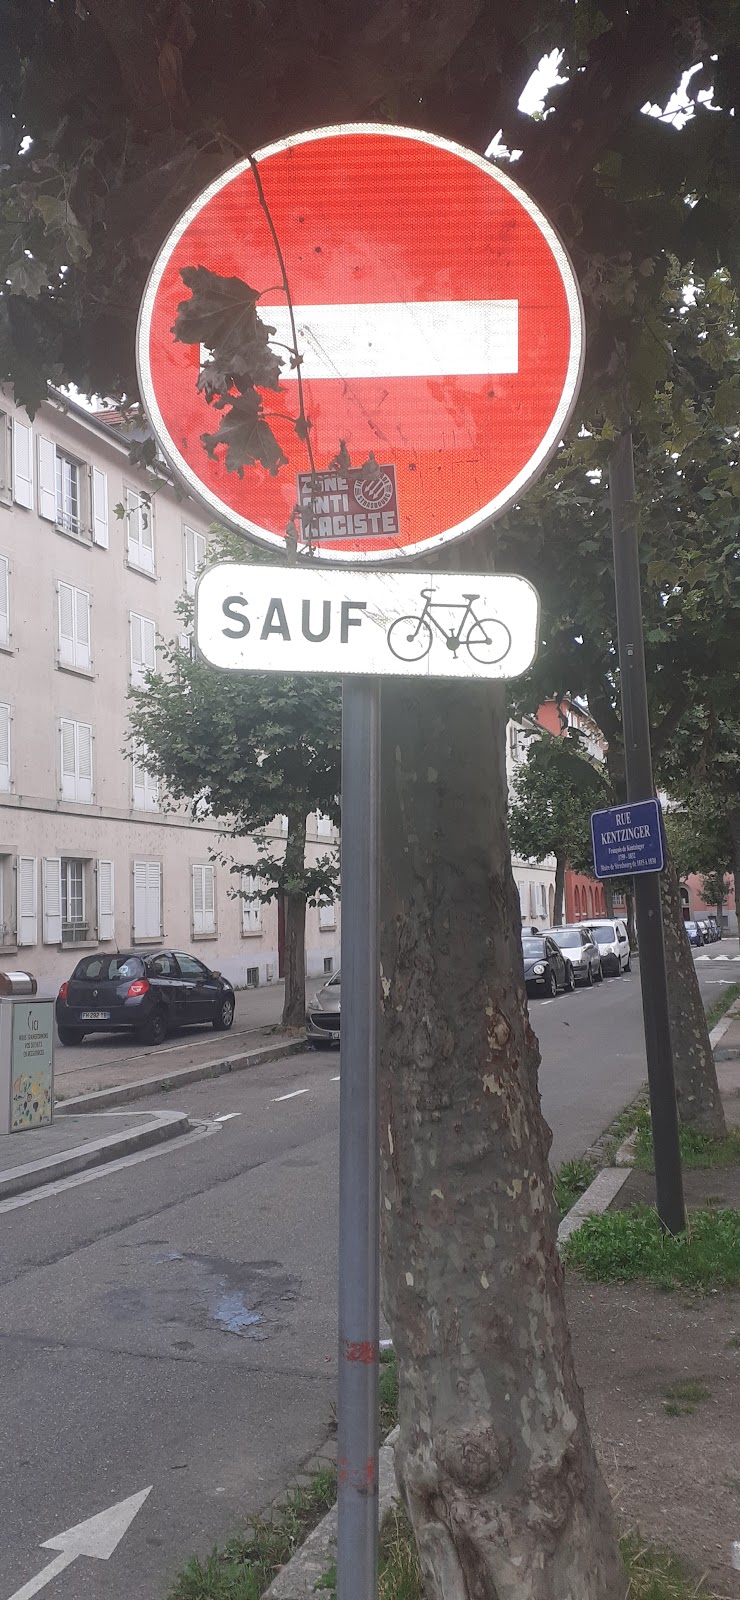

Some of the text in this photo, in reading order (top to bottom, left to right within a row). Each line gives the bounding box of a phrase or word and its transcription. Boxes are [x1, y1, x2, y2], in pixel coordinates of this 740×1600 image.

[357, 493, 391, 509] STRASBOURG
[221, 595, 368, 644] SAUF
[615, 812, 632, 827] RUE
[601, 825, 651, 845] KENTZINGER
